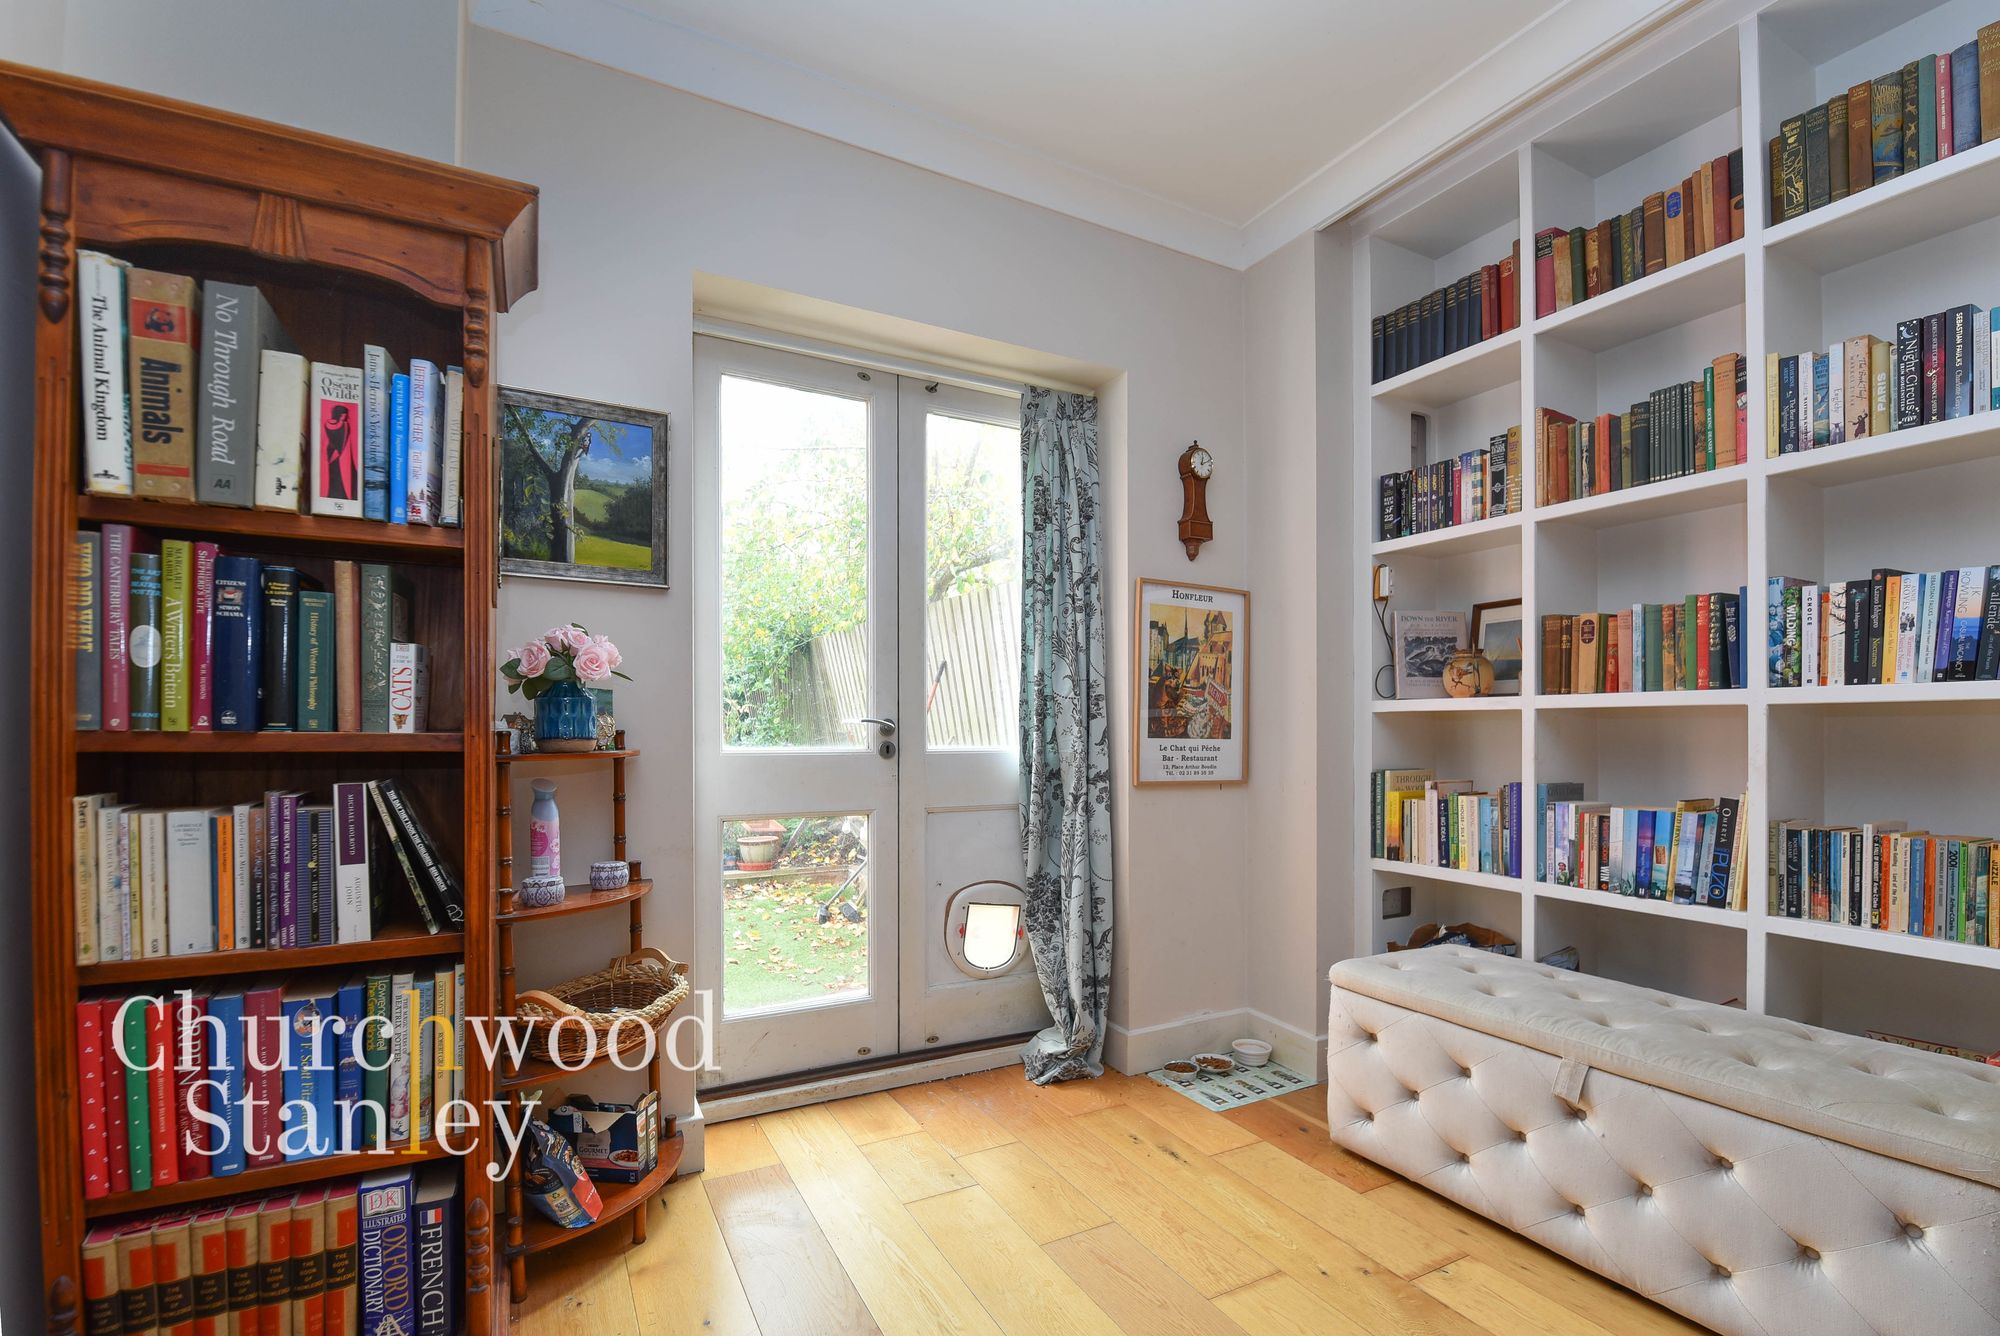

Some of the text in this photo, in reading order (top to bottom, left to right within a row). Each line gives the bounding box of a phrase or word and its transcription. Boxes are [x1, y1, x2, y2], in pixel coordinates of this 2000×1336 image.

[90, 295, 112, 441] The Animal Kingdom
[1954, 312, 1964, 397] SEBASTIAN FAULKS Charlotte
[207, 294, 239, 465] No Through Road
[320, 385, 360, 401] Wilde
[321, 377, 360, 391] Oscar
[411, 364, 428, 403] JEFFREY
[1855, 358, 1867, 402] The Book Thief
[1876, 372, 1887, 412] PARIS
[1902, 340, 1919, 412] Night Circus
[140, 357, 184, 445] Animals
[367, 352, 382, 463] James Herriot's Yorkshire
[395, 380, 405, 431] PETER MAYLE
[1780, 405, 1790, 434] Nightingale
[1789, 398, 1797, 438] The Bear and the
[411, 404, 424, 443] ARCHER
[214, 478, 231, 489] AA
[411, 464, 422, 480] Tale
[1384, 506, 1394, 515] SF
[1384, 515, 1394, 523] 22
[165, 545, 175, 582] DRABBLE
[173, 547, 183, 591] MARGARET
[195, 549, 209, 615] SHEPHERD'S LIFE
[73, 542, 93, 653] WHO DID WHAT
[108, 532, 122, 661] THE CANTERBURY TALES
[215, 579, 247, 587] CITIZENS
[1902, 577, 1913, 611] GROVES
[1929, 574, 1937, 601] SEBASTIAN
[1956, 571, 1972, 614] ROWLING
[1400, 614, 1458, 622] DOWN RIVER
[1852, 612, 1862, 630] Ishiguro
[1853, 599, 1862, 612] Kazuo
[1986, 592, 2000, 630] allende
[1785, 604, 1797, 647] WILDING
[1871, 585, 1883, 668] Kazuo Ishiguro Nocturnes
[163, 596, 183, 709] A Britain
[306, 612, 320, 711] History of Western Philosophy
[1955, 620, 1968, 672] CASUAL VACANCY
[198, 676, 208, 701] HUDSON
[391, 666, 413, 711] CATS
[1159, 744, 1168, 752] Le
[1169, 744, 1187, 752] Chat
[1188, 744, 1200, 754] qui
[1162, 754, 1218, 762] Bar Restaurant
[387, 789, 397, 800] THE
[1395, 775, 1432, 785] THROUGH
[283, 799, 292, 819] SECRET
[393, 799, 403, 811] DAY
[396, 809, 408, 822] THEY
[239, 812, 248, 836] Gabriel
[283, 821, 292, 841] HIDING
[347, 793, 357, 856] MICHAEL HOLROYD
[402, 820, 415, 835] TOOK
[283, 842, 292, 864] PLACES
[413, 843, 433, 867] CHILDREN
[1600, 818, 1610, 882] Harlan WIN
[1891, 852, 1899, 867] Golding
[283, 870, 292, 892] Michael
[311, 832, 320, 914] JOHN THE MAGUS
[1709, 851, 1730, 899] PUZO
[1990, 859, 1999, 886] JIZZLE
[345, 885, 354, 906] JOHN
[353, 876, 363, 914] AUGUSTUS
[367, 981, 378, 997] The
[393, 995, 403, 1063] BEATRIX POTTER
[401, 998, 409, 1046] THE MAGIC YEARS
[177, 1004, 203, 1086] ORPEN
[437, 1032, 445, 1057] ROBERT
[300, 1055, 314, 1080] Scott
[178, 1088, 189, 1113] BRUCE
[363, 1212, 407, 1230] ILLUSTRATED
[362, 1229, 385, 1313] DICTIONARY
[382, 1225, 410, 1311] OXFORD
[420, 1225, 445, 1328] FRENCH
